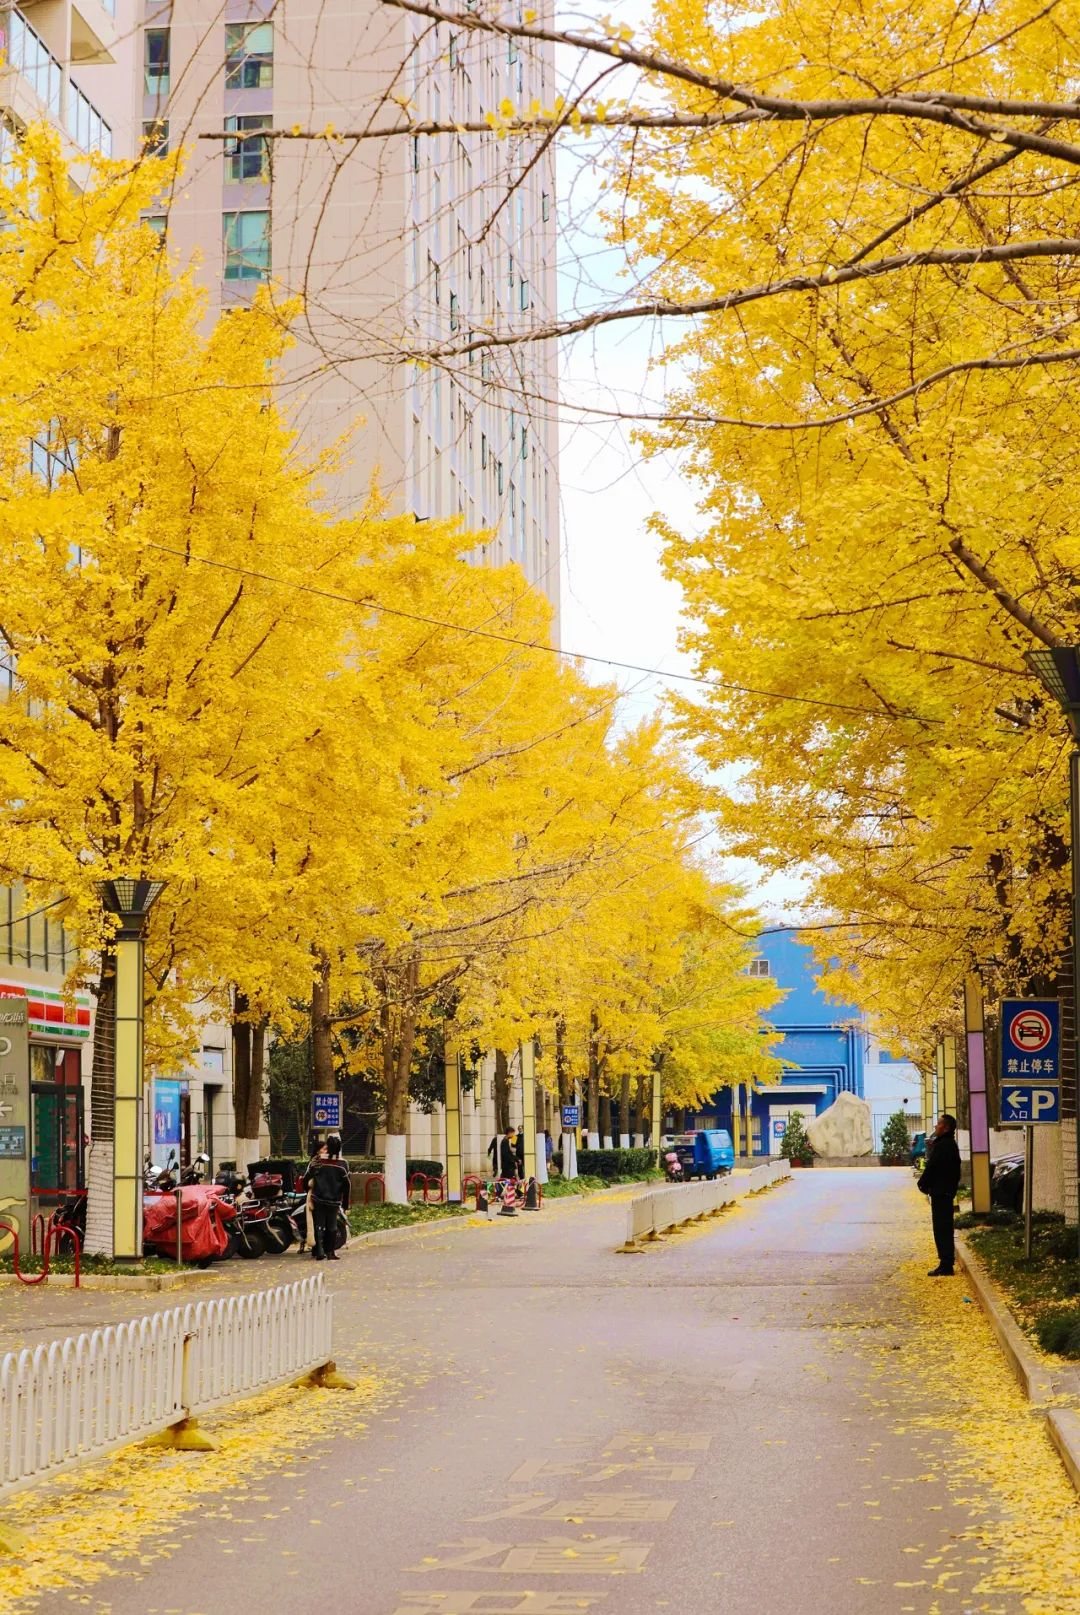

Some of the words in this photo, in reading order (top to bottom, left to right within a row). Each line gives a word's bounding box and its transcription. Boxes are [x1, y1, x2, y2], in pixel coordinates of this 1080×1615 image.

[1007, 1058, 1054, 1074] 禁止停车
[1031, 1090, 1055, 1119] P
[1009, 1110, 1028, 1119] 入口
